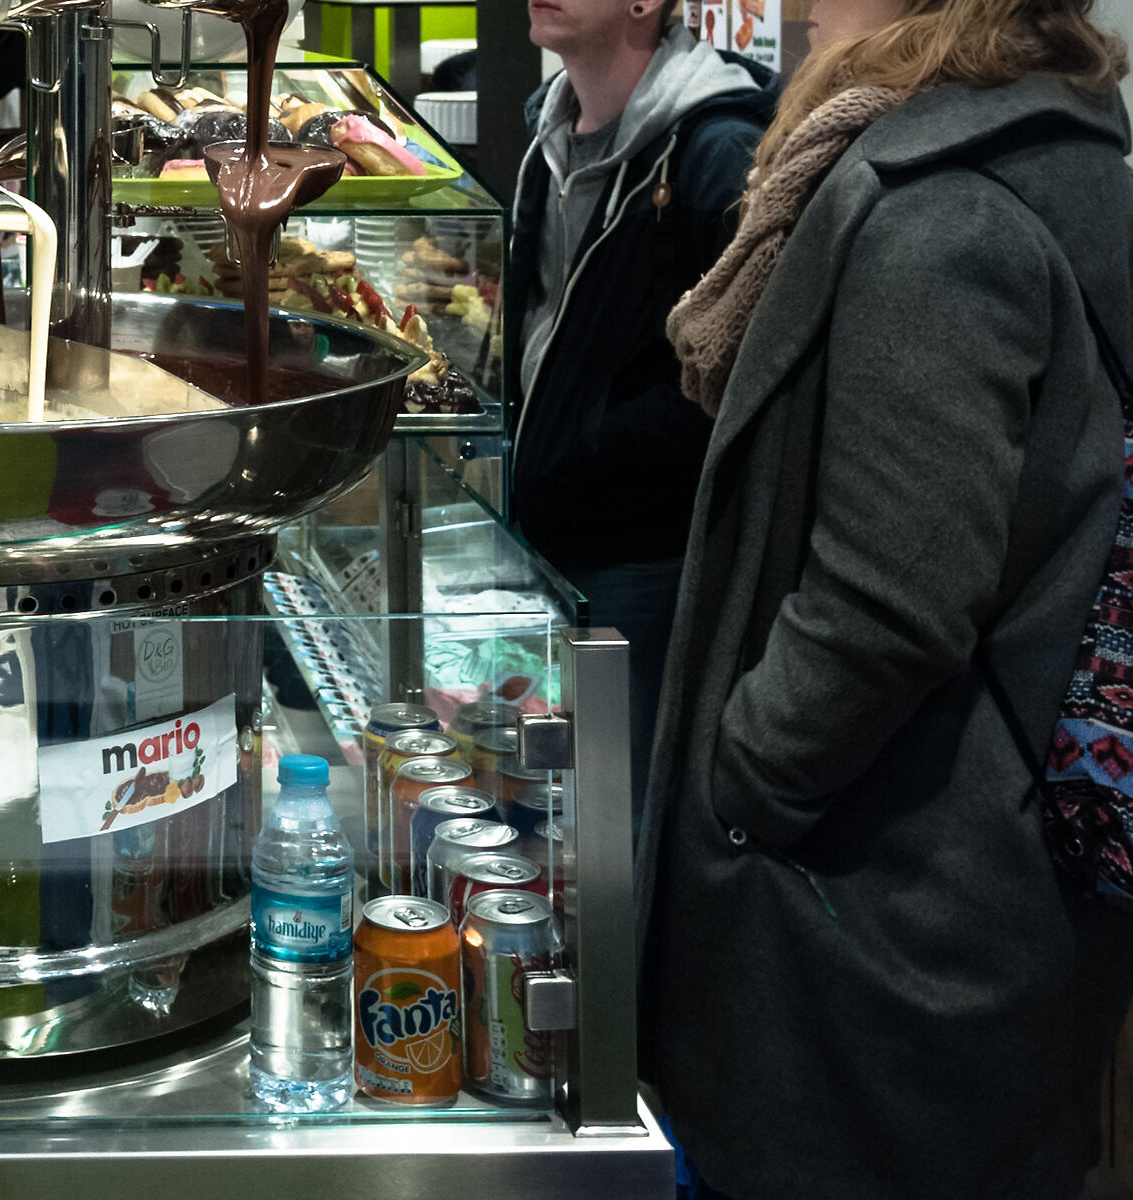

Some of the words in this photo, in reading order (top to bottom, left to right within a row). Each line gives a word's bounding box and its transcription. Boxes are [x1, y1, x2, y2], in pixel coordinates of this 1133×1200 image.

[140, 602, 189, 627] SURFACE
[102, 719, 201, 775] mario
[268, 915, 326, 943] hamidiye
[359, 987, 458, 1049] Fanta
[374, 1052, 411, 1074] ORANGE
